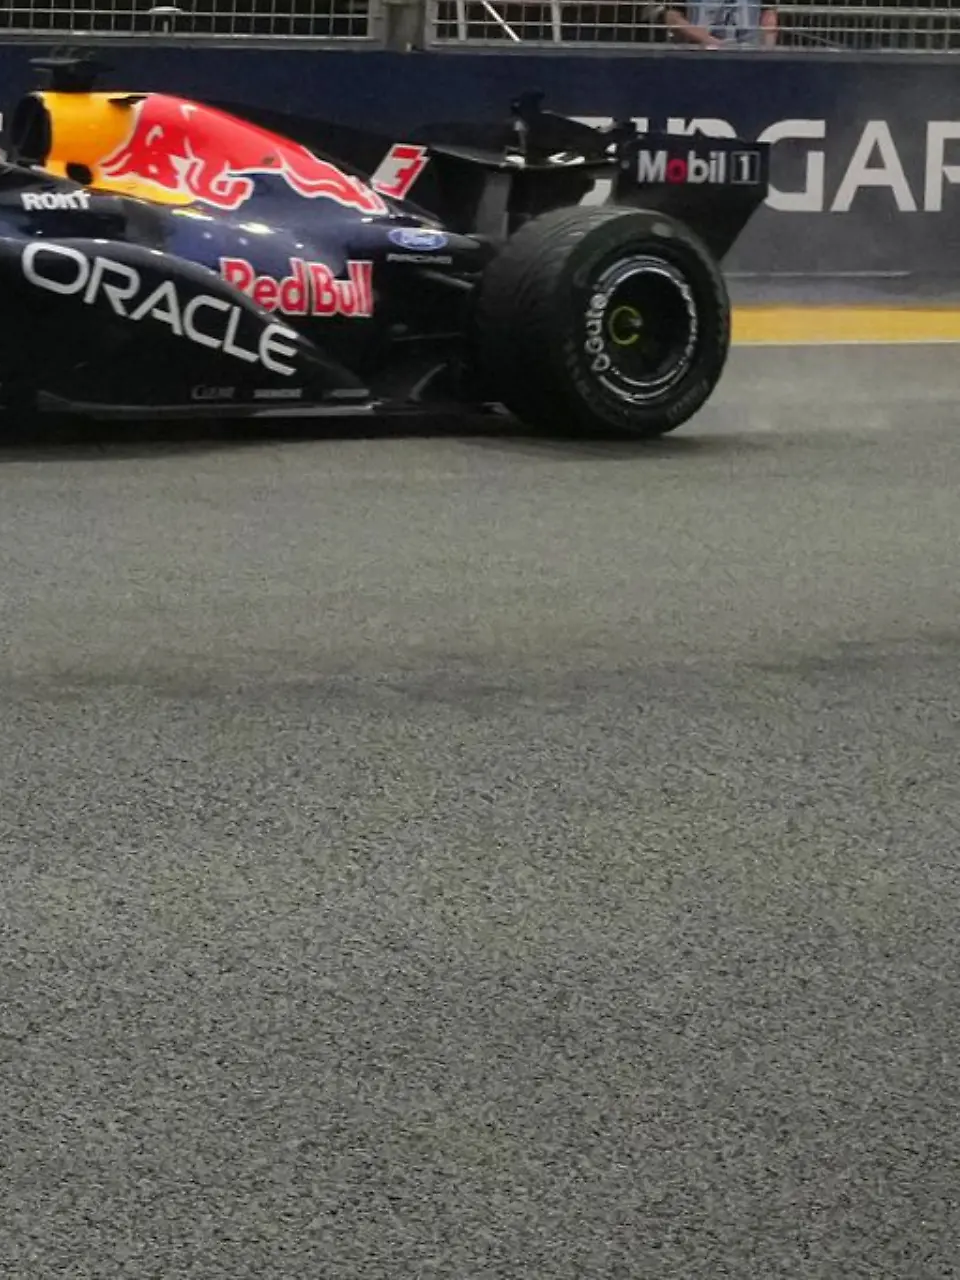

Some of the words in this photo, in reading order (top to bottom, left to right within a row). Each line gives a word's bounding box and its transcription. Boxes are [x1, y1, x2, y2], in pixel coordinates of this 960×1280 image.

[637, 150, 725, 184] Mobil
[21, 189, 90, 211] ROKT
[21, 241, 300, 376] ORACLE
[220, 257, 308, 315] Red
[307, 260, 373, 317] Bull
